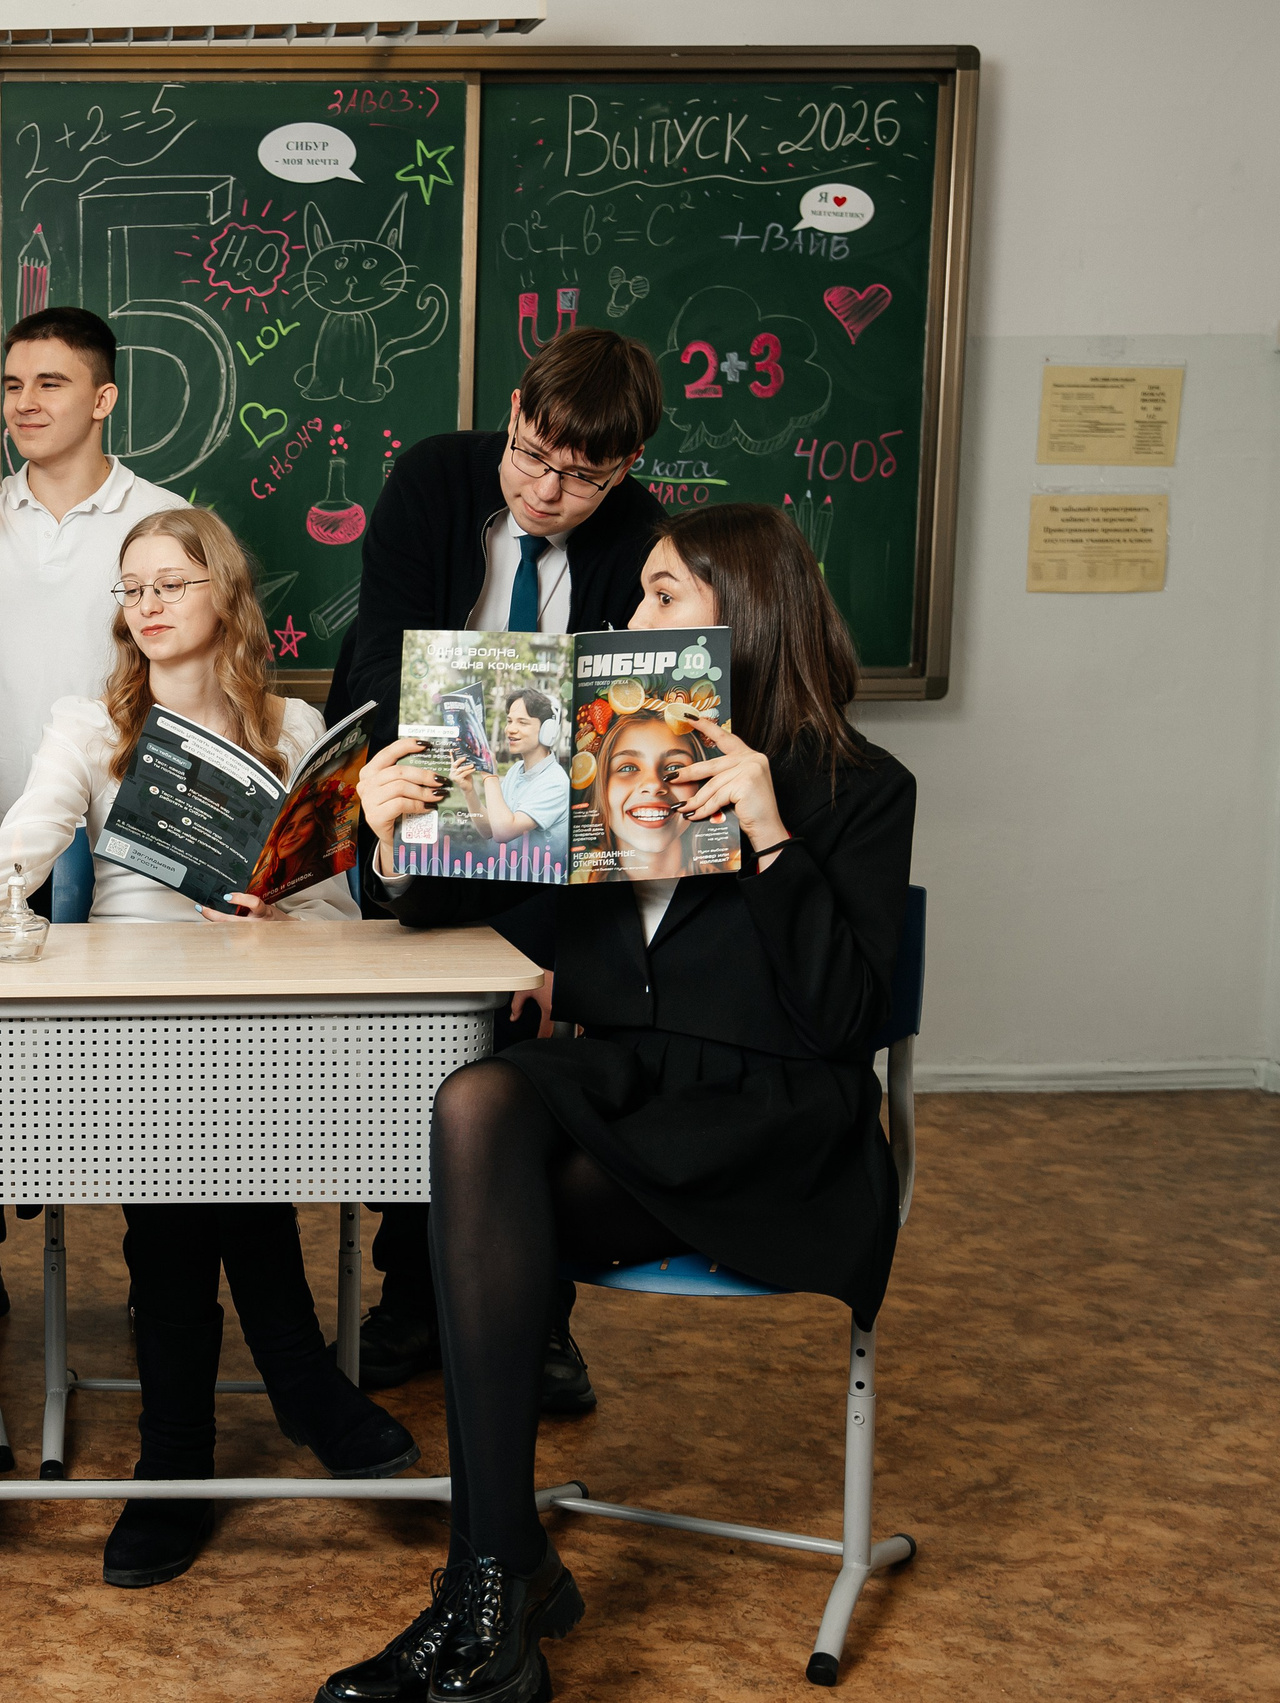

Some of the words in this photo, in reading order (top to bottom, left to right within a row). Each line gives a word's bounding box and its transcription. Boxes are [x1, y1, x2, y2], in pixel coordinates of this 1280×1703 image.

[778, 99, 901, 157] 2026
[286, 141, 329, 152] СИБУР
[283, 158, 303, 166] моя
[307, 158, 339, 166] мечта
[818, 192, 828, 203] Я
[236, 319, 300, 366] LOL
[427, 645, 463, 656] Одна
[468, 646, 520, 659] волна,
[451, 662, 484, 670] одна
[488, 662, 550, 672] команда!
[577, 651, 677, 679] СИБУР
[683, 653, 705, 670] IQ
[573, 850, 636, 860] НЕОЖИДАННЫЕ
[573, 859, 617, 868] ОТКРЫТИЯ,
